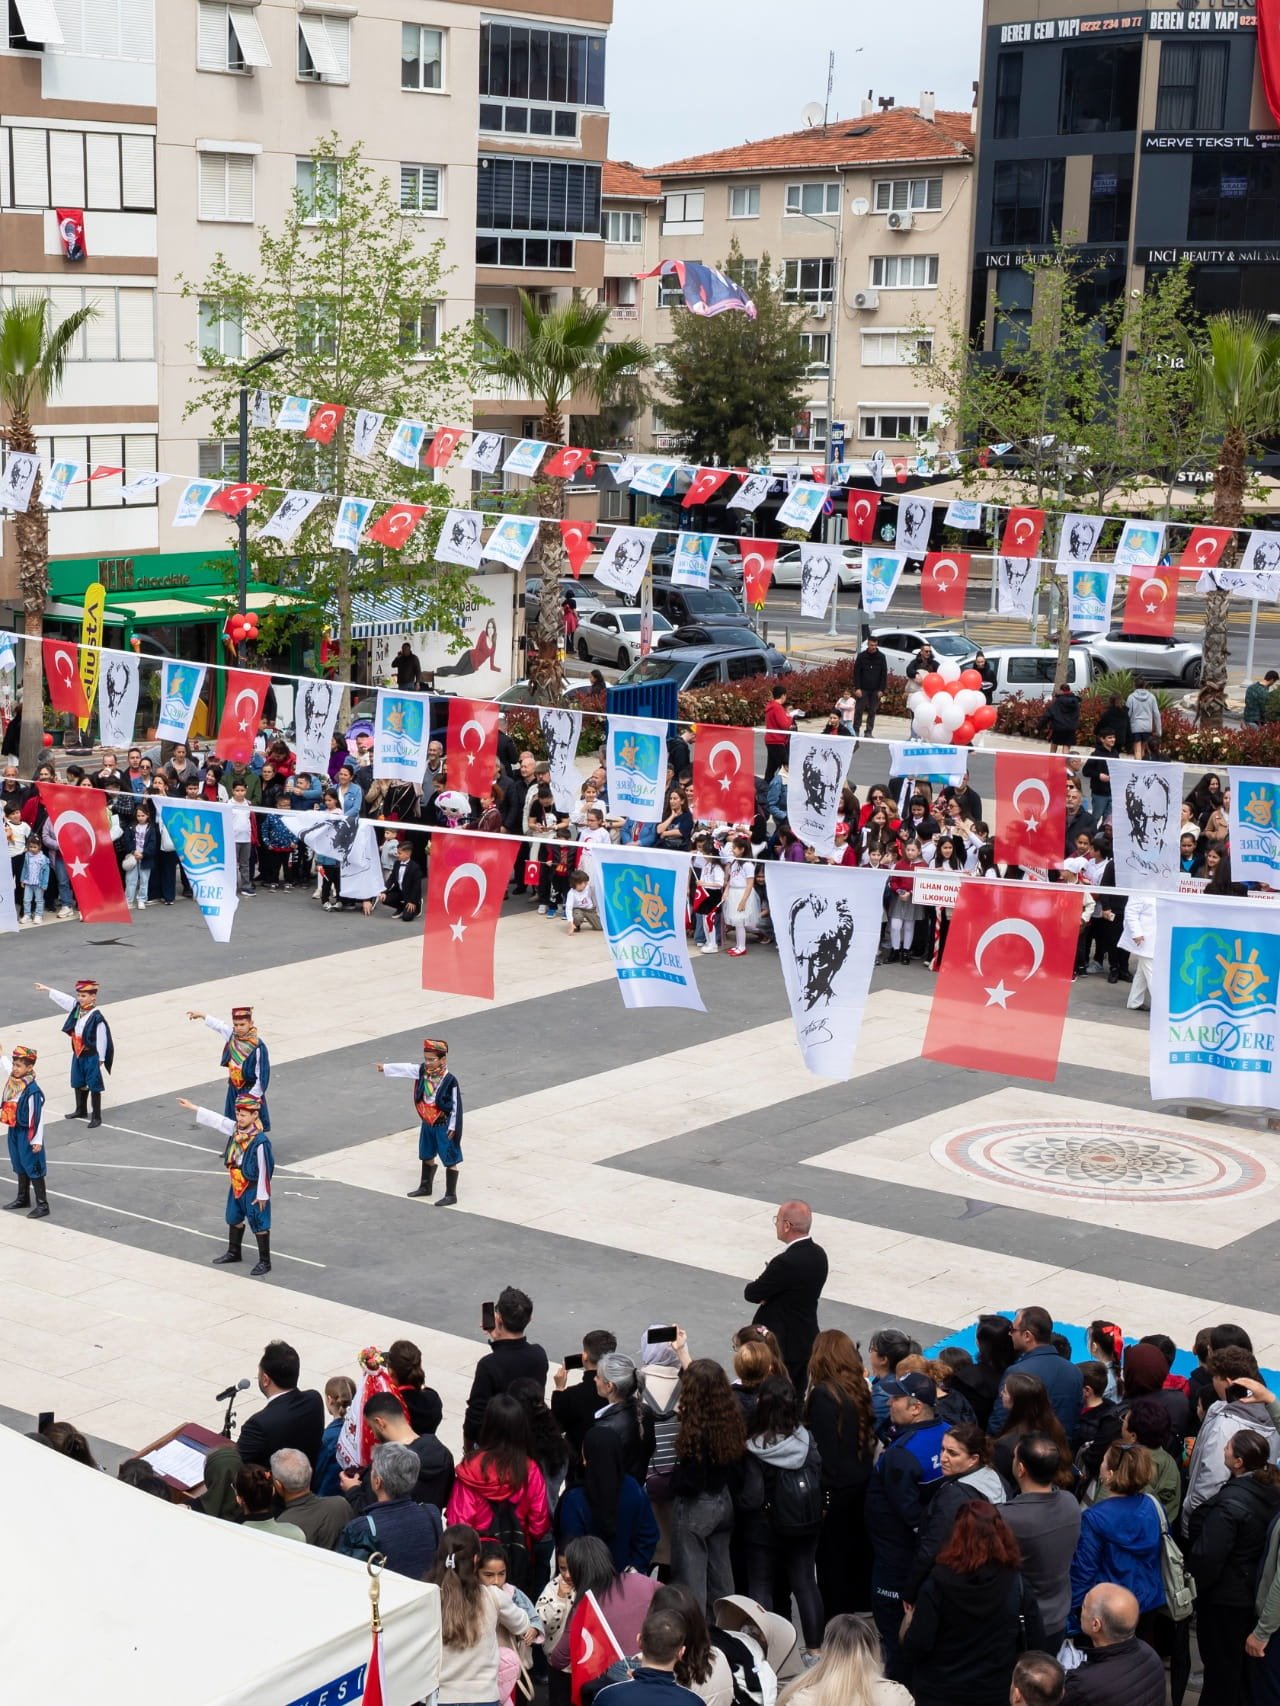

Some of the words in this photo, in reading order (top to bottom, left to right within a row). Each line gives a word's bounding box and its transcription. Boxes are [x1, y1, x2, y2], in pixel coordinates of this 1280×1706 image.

[1150, 12, 1184, 30] BEREN
[1187, 12, 1210, 30] CEM
[1214, 12, 1239, 30] YAPI
[1239, 15, 1258, 26] 023
[1001, 23, 1031, 43] BEREN
[1034, 21, 1054, 40] CEM
[1058, 19, 1080, 38] YAPI
[1146, 137, 1193, 148] MERVE
[1196, 136, 1254, 148] TEKSTİL
[1184, 250, 1224, 262] BEAUTY
[1227, 250, 1235, 262] &
[136, 571, 191, 589] chocolate
[920, 881, 943, 891] İLHAN
[1169, 1021, 1276, 1052] NARLIDERE
